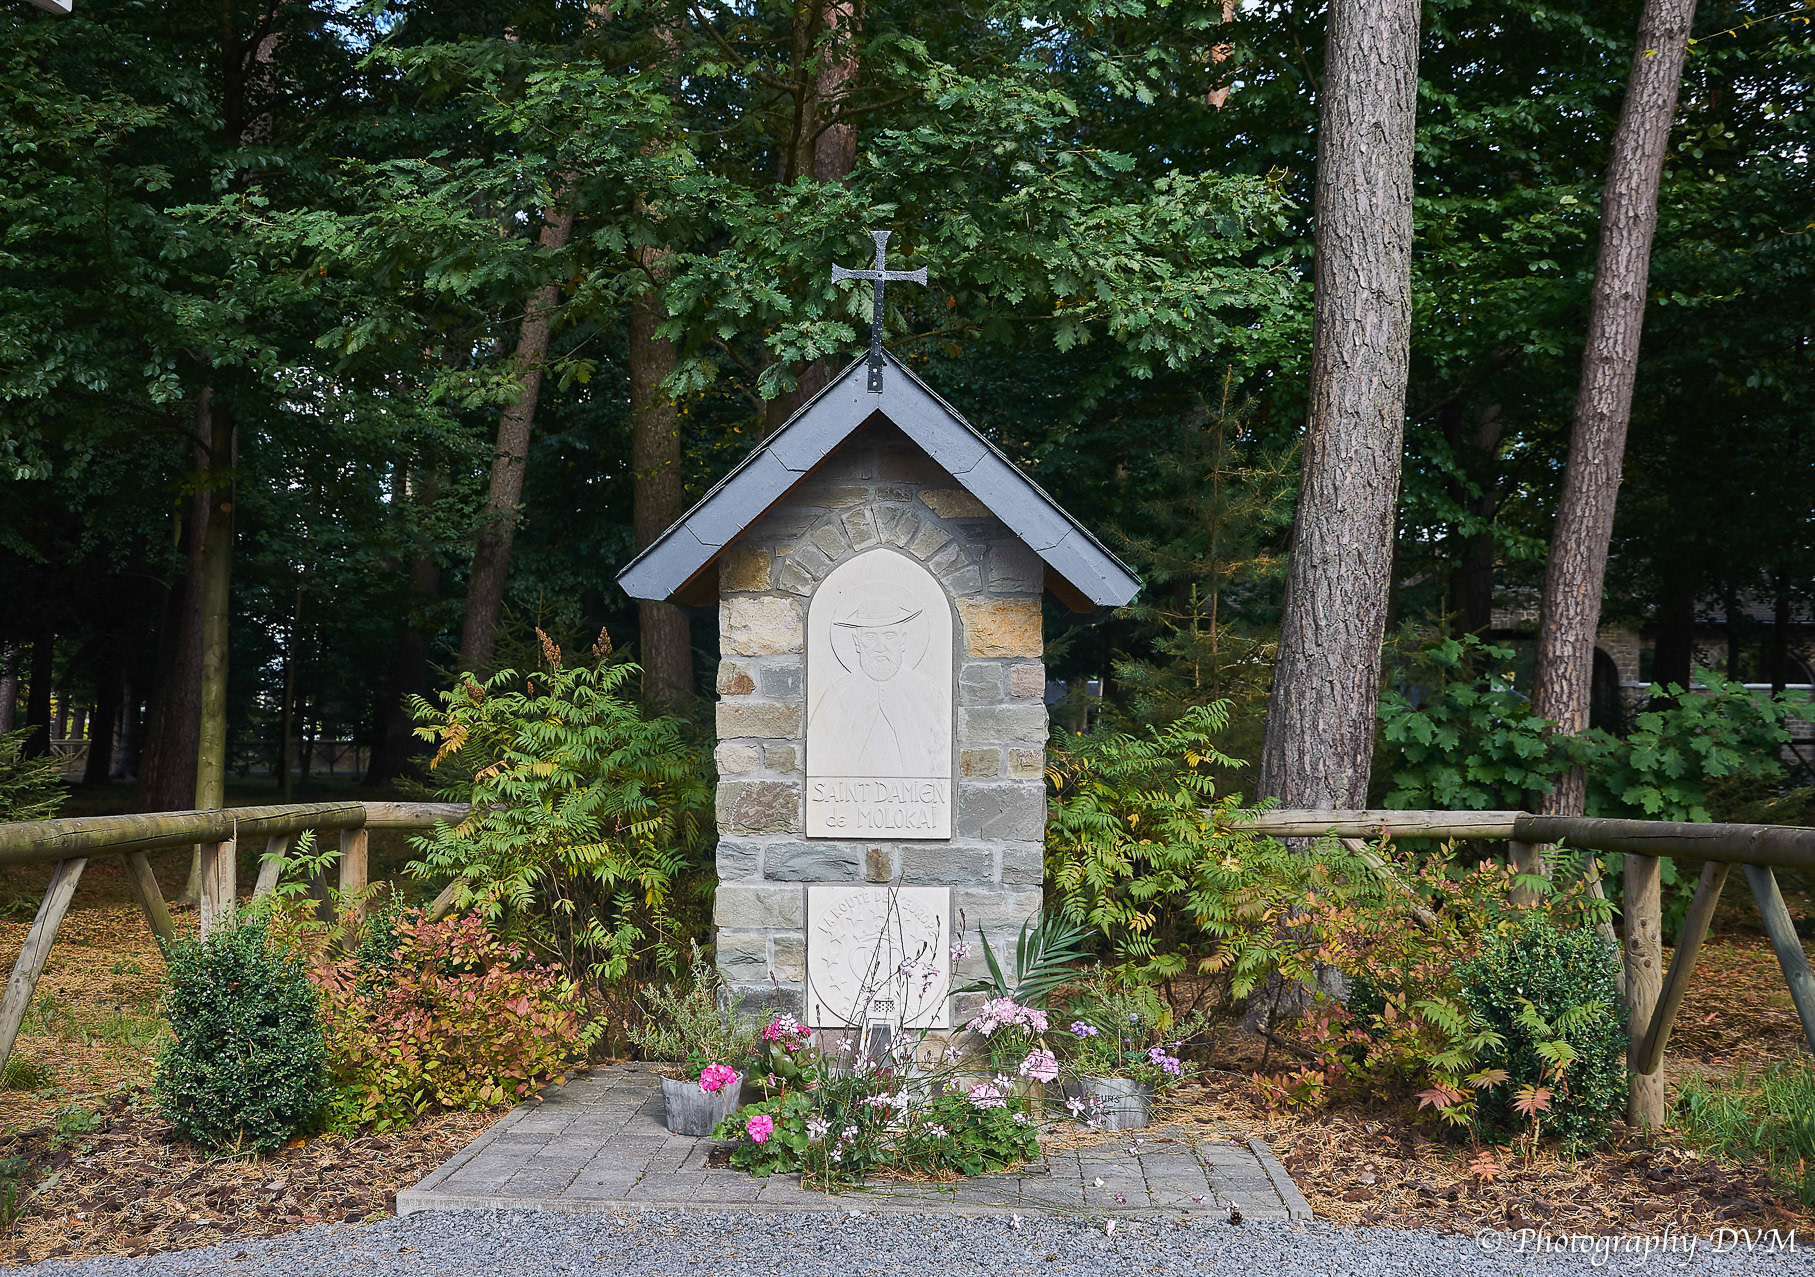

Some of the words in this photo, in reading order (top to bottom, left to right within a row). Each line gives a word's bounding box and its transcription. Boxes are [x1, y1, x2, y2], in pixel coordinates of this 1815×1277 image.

[812, 781, 870, 803] SAINT
[873, 780, 946, 804] DAMIEN
[825, 805, 848, 828] de
[830, 892, 870, 919] ROUTE
